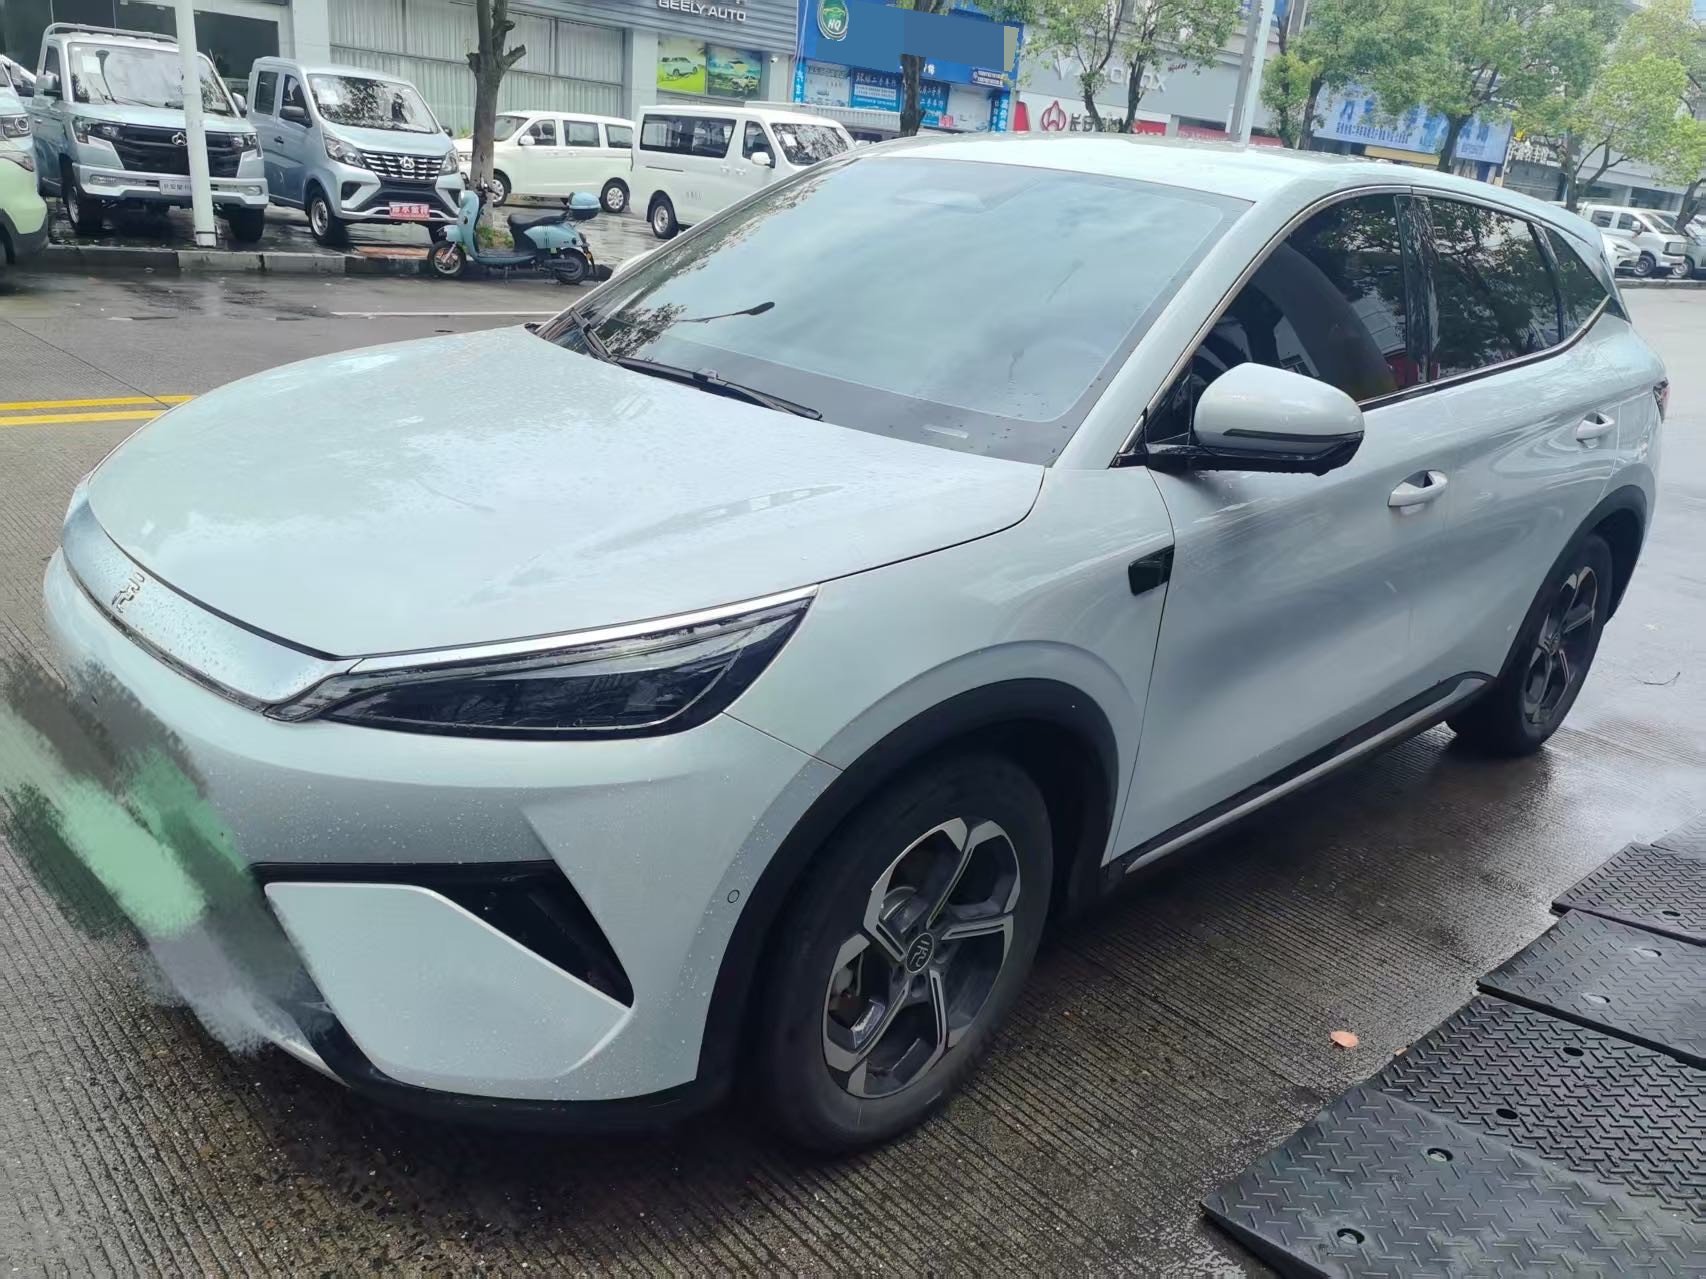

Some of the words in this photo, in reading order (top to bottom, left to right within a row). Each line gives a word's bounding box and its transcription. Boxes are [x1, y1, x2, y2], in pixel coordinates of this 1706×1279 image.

[659, 0, 705, 15] GEELY
[708, 6, 747, 22] AUTO
[827, 18, 842, 31] HQ
